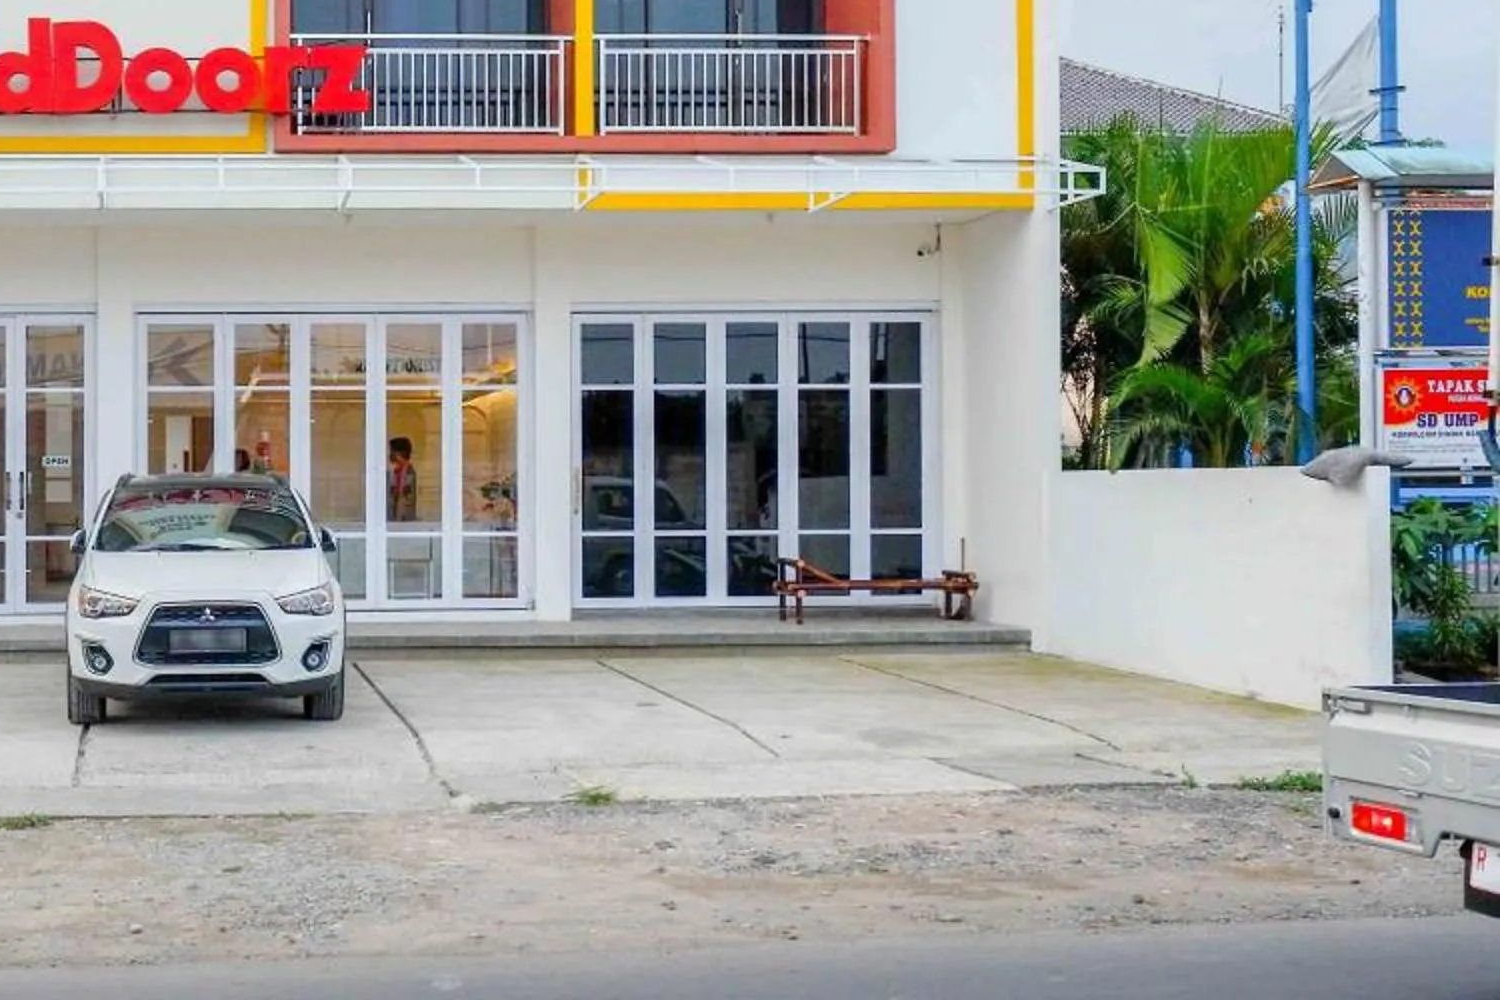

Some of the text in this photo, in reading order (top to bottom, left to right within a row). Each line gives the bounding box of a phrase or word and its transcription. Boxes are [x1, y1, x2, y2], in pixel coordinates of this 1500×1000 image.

[1427, 379, 1475, 393] TAPAK
[1417, 413, 1479, 428] SD UMP
